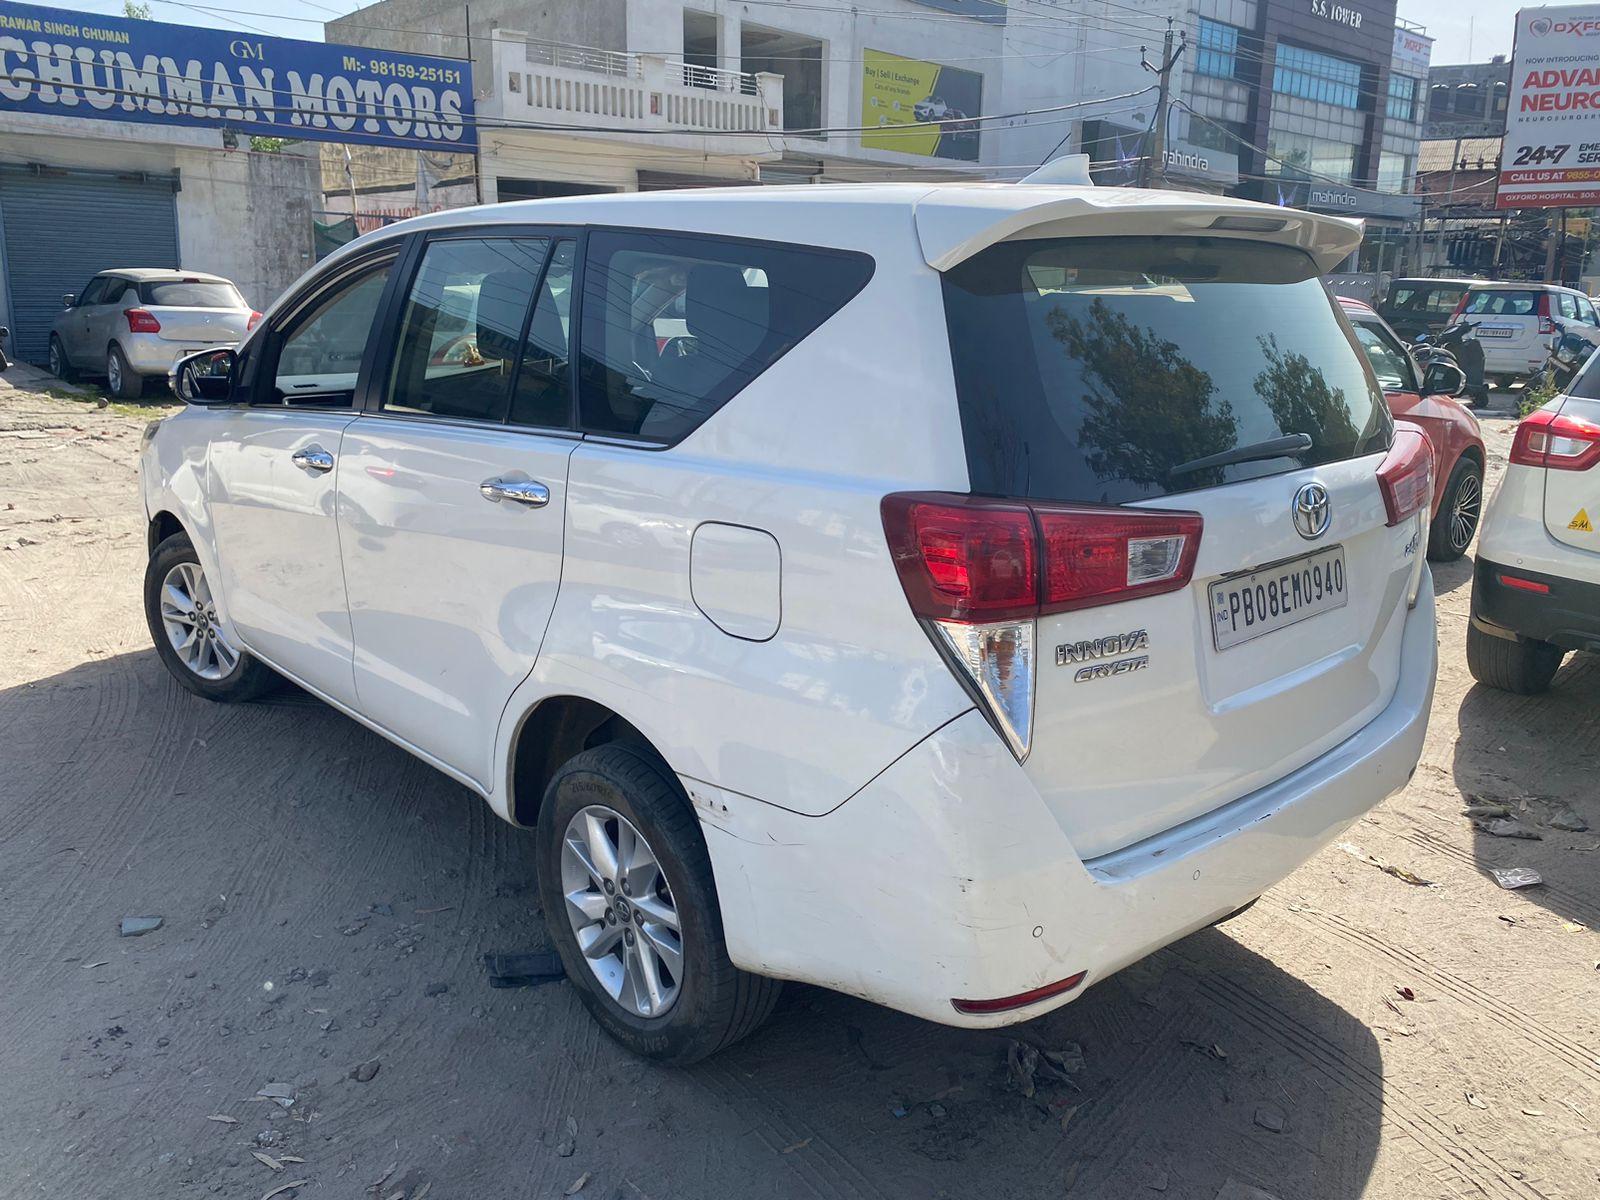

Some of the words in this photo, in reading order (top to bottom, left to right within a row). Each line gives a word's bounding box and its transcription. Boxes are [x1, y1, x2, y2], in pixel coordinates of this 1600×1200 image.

[44, 21, 79, 37] SINGH
[81, 26, 130, 44] GHUMAN
[229, 40, 264, 61] GM
[1546, 54, 1600, 63] INTRODUCING
[370, 59, 461, 85] 98159-25151
[865, 66, 876, 77] Buy
[880, 70, 891, 78] Sell
[895, 73, 919, 86] Exchange
[1523, 68, 1600, 89] ADVA
[0, 36, 276, 124] GHUMMAN
[287, 71, 464, 142] MOTORS
[1511, 173, 1535, 182] CALL
[1537, 173, 1551, 181] US
[1551, 172, 1565, 180] AT
[1312, 190, 1357, 206] mahindra
[1505, 193, 1537, 201] OXFORD
[1569, 519, 1588, 529] SM
[1228, 558, 1343, 631] PB08EM0940
[1216, 609, 1228, 622] IND
[1055, 629, 1149, 666] INNOVA
[1074, 655, 1149, 683] CRYSTA
